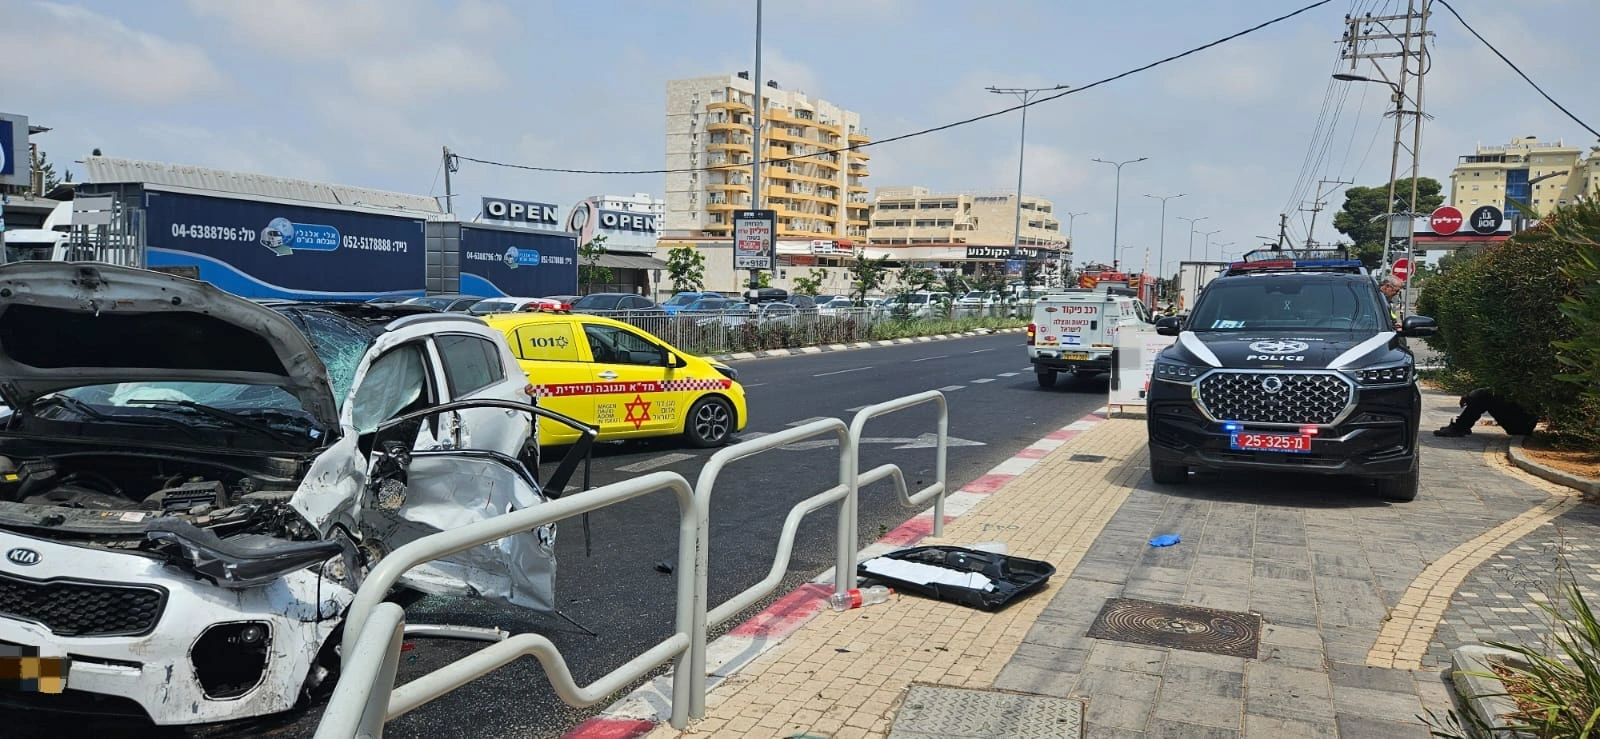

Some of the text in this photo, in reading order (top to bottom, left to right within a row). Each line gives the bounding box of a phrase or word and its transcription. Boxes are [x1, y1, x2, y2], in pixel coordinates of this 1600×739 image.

[488, 201, 558, 221] OPEN
[603, 213, 657, 231] OPEN
[171, 223, 237, 241] 04-6388796
[342, 234, 392, 252] 052-5178888
[967, 246, 1010, 259] הקולנוע
[1062, 305, 1082, 314] פיקוד
[1083, 306, 1098, 314] רכב
[530, 337, 555, 348] 101
[555, 382, 655, 394] מד"א תגובה מיידית
[10, 549, 35, 563] KIA
